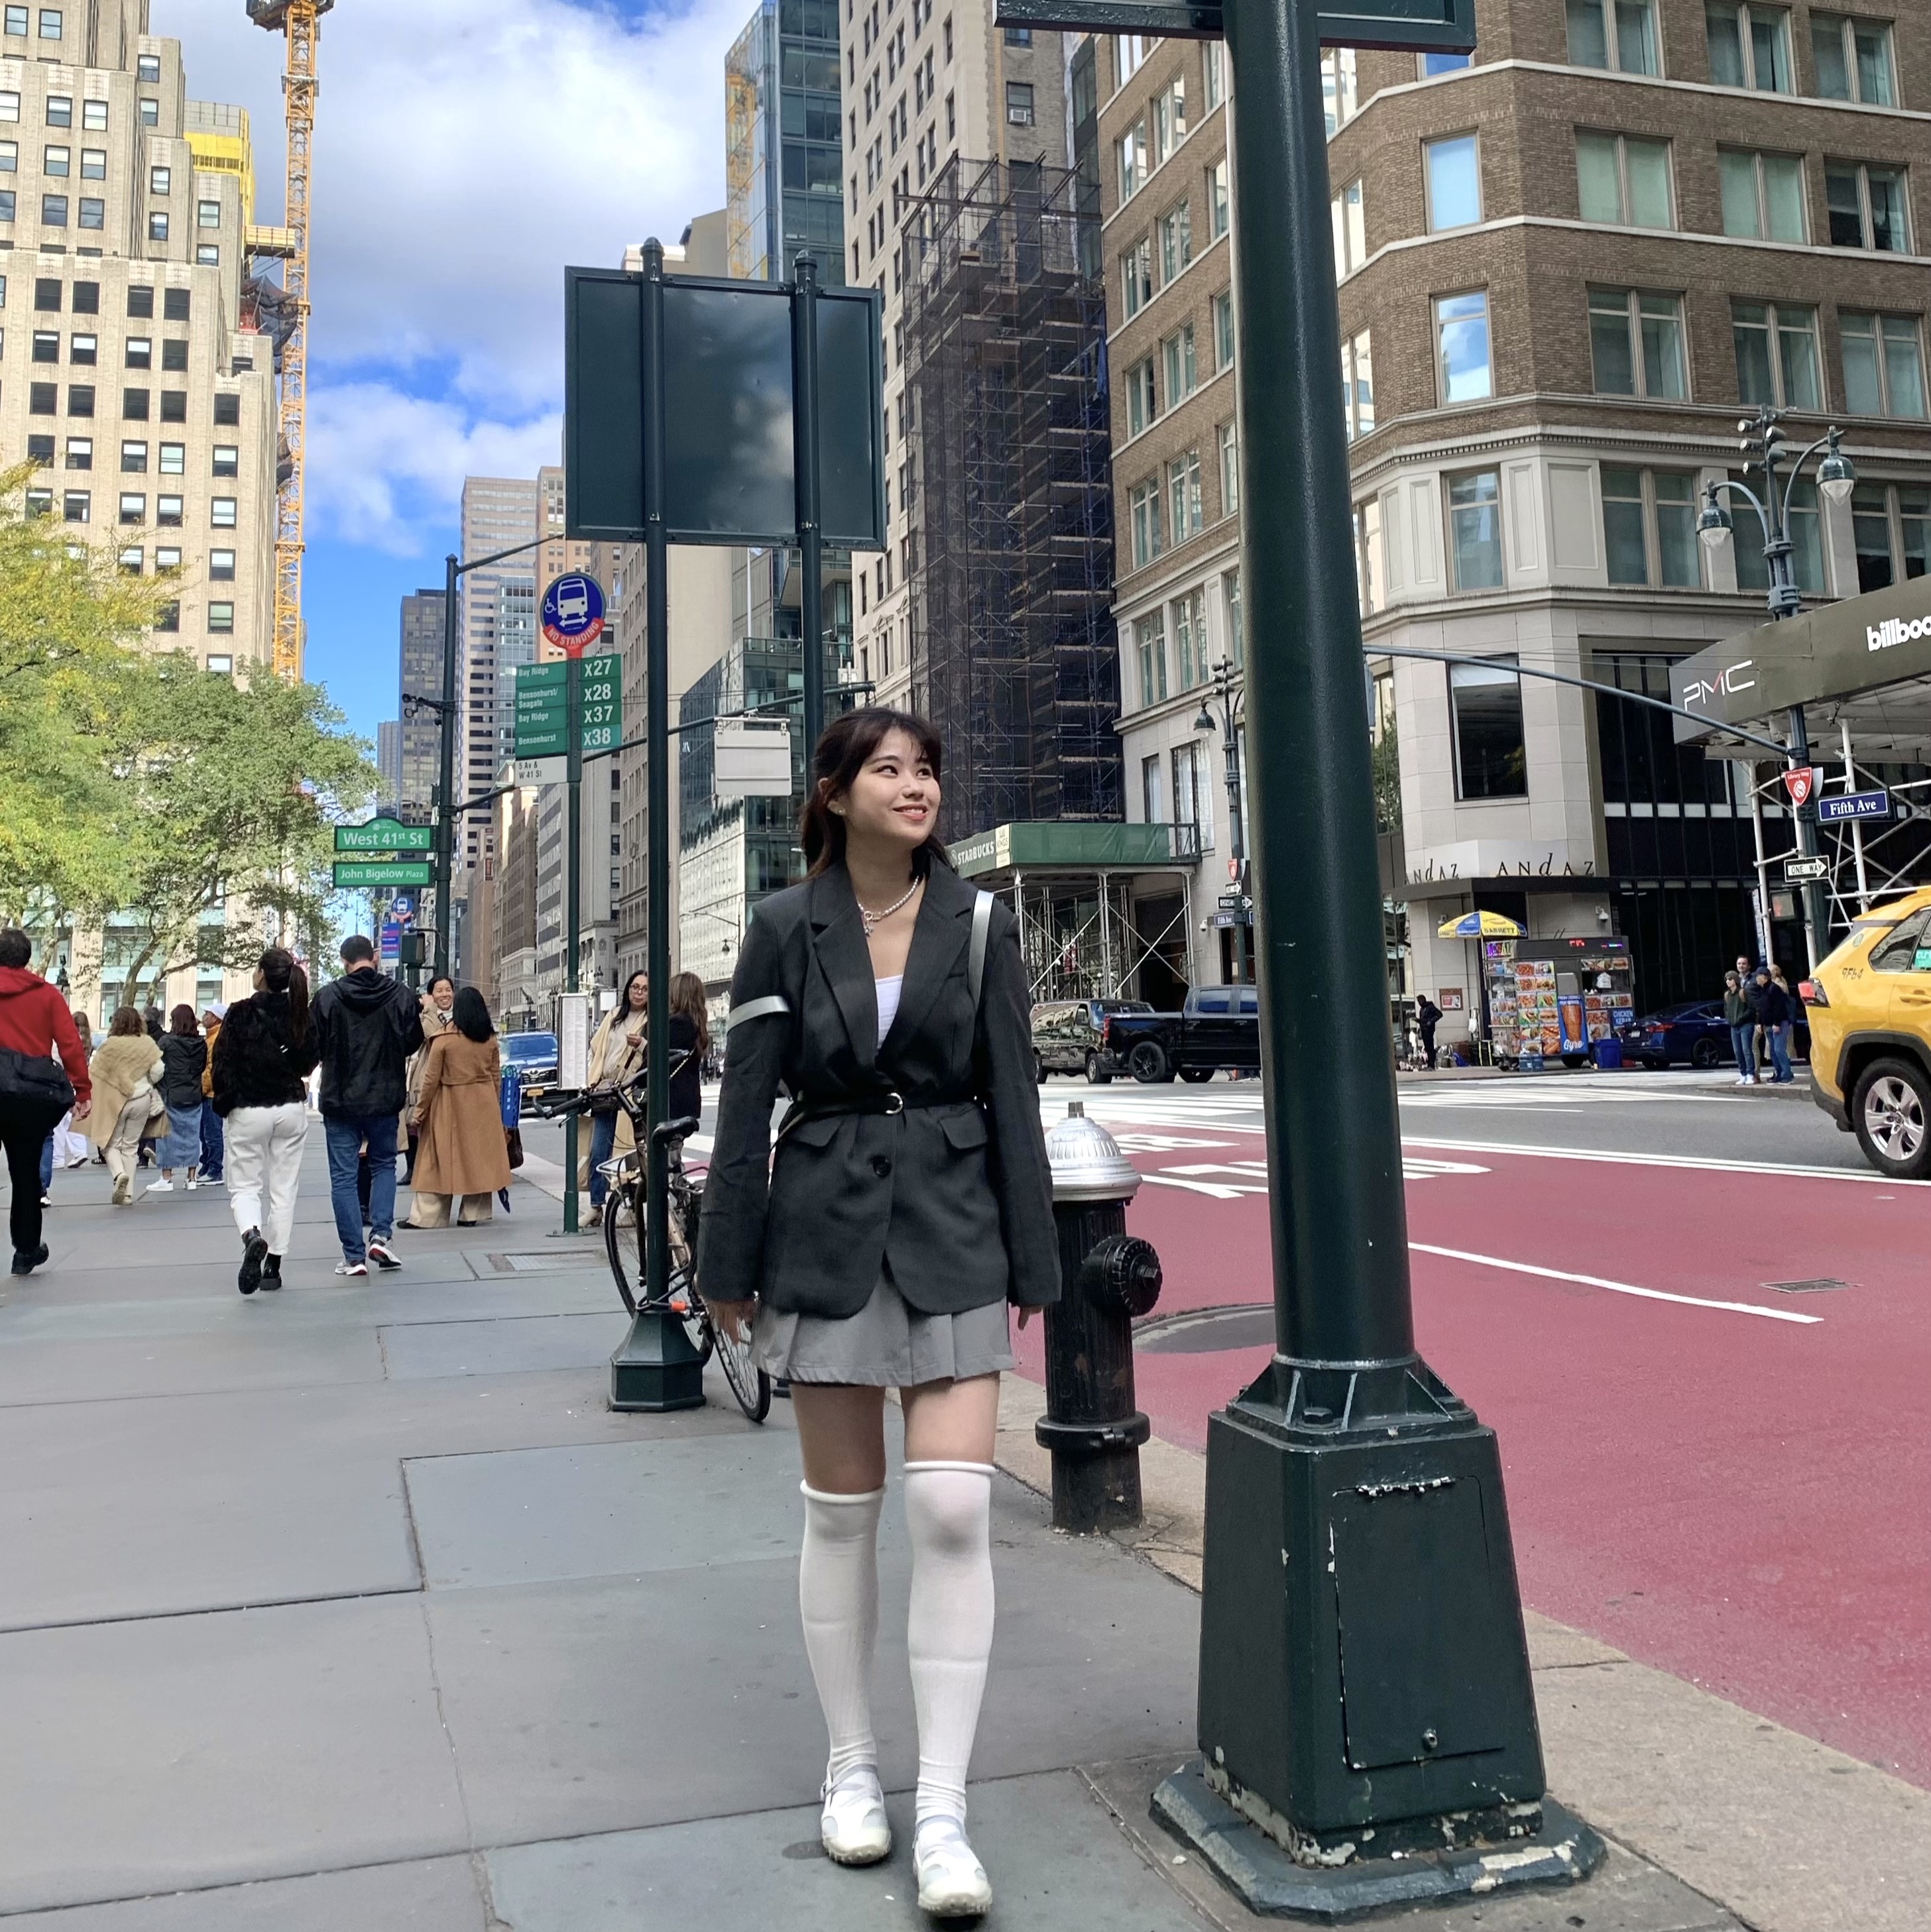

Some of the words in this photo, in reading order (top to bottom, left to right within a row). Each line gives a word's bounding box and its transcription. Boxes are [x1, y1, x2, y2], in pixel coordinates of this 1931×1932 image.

[548, 628, 559, 642] NO
[559, 622, 599, 646] STANDING
[518, 668, 530, 677] Bay
[531, 667, 549, 675] Ridge
[1683, 660, 1755, 711] PMC
[518, 699, 543, 709] Seagate
[518, 714, 530, 723] Bay
[531, 712, 549, 721] Ridge
[518, 734, 556, 745] Bensonhurst
[1830, 801, 1855, 816] Fifth
[1857, 800, 1877, 813] Ave
[343, 832, 379, 845] West
[381, 832, 406, 845] 41st
[410, 832, 423, 845] St
[958, 841, 994, 866] STARBUCKS
[341, 869, 363, 879] John
[366, 868, 404, 880] Bigelow
[1791, 866, 1804, 874] ONE
[1564, 1039, 1584, 1051] Gyro
